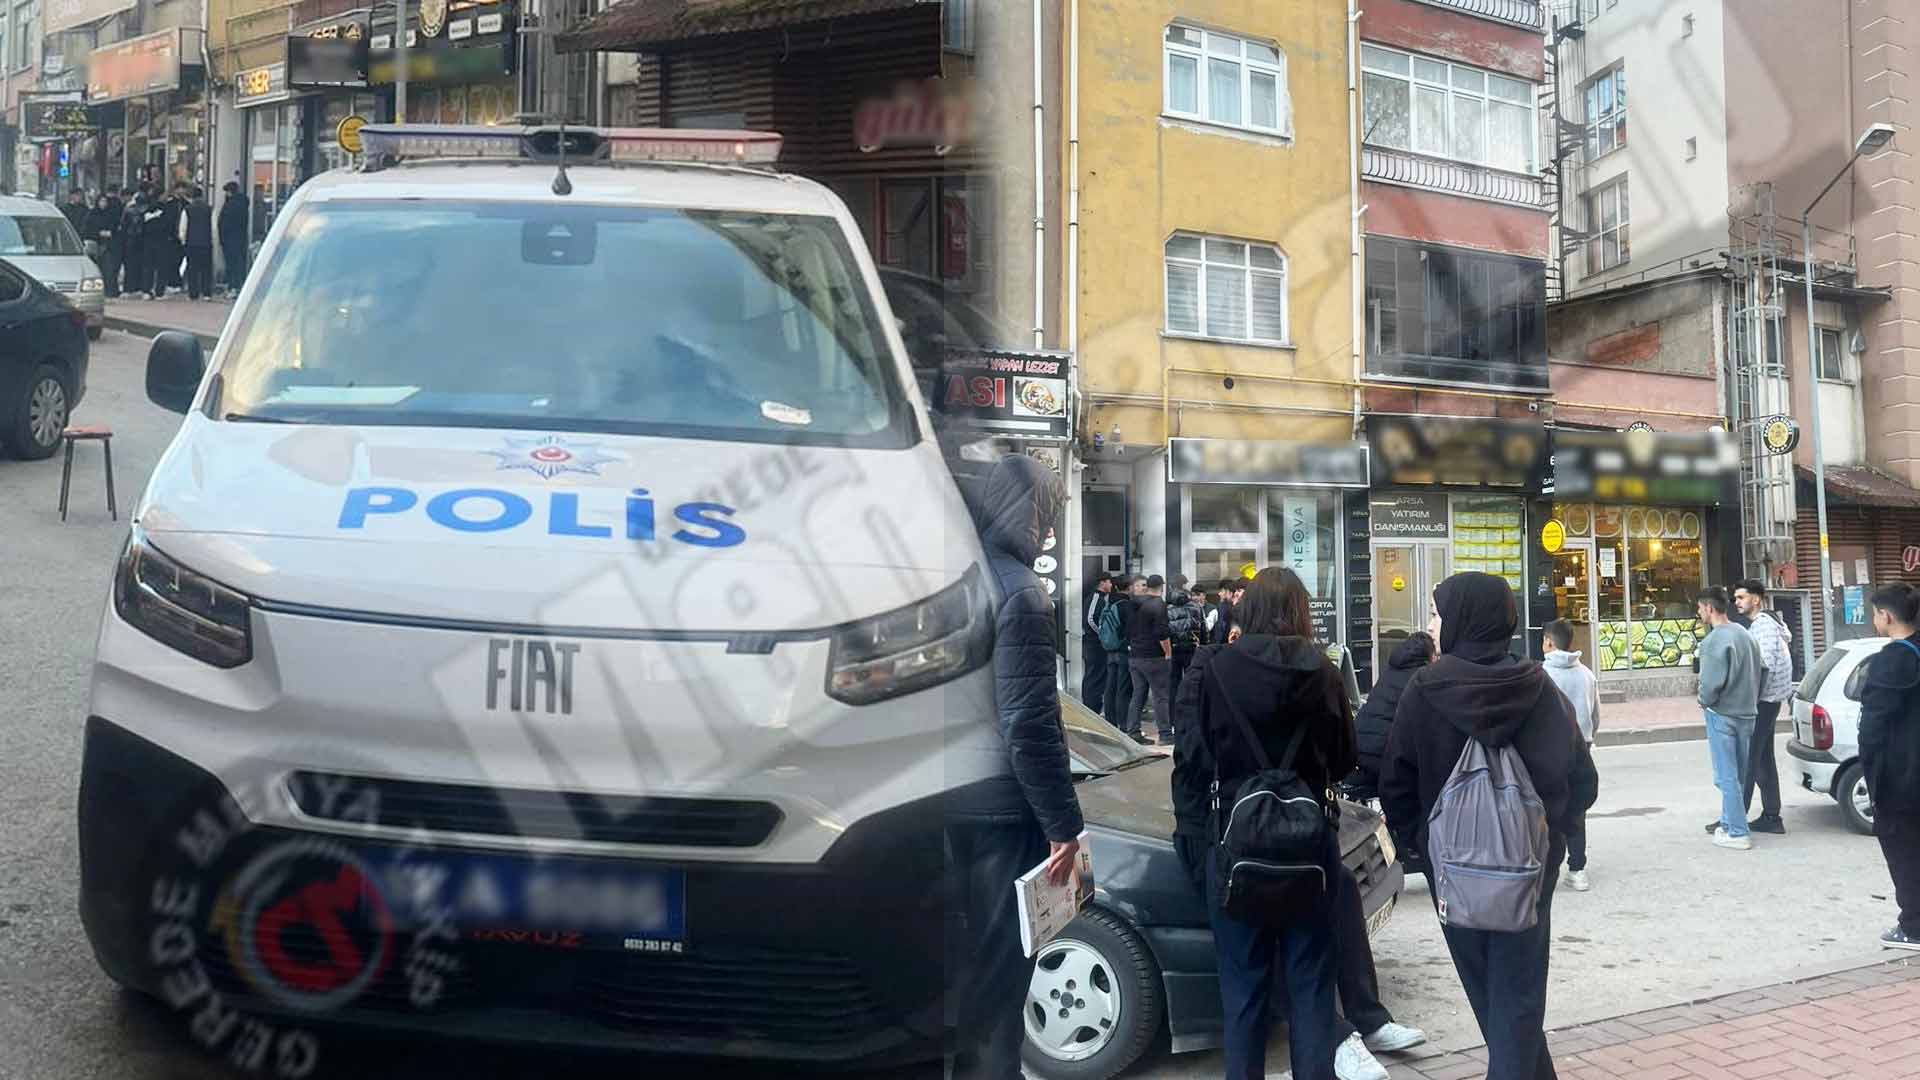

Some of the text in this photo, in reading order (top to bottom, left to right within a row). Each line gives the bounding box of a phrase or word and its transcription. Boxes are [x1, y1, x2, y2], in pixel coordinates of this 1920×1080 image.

[1025, 359, 1060, 375] LEZZET
[337, 487, 747, 548] POLİS
[1292, 506, 1305, 568] NEOVA
[1391, 510, 1430, 518] YATIRIM
[486, 638, 581, 715] FIAT
